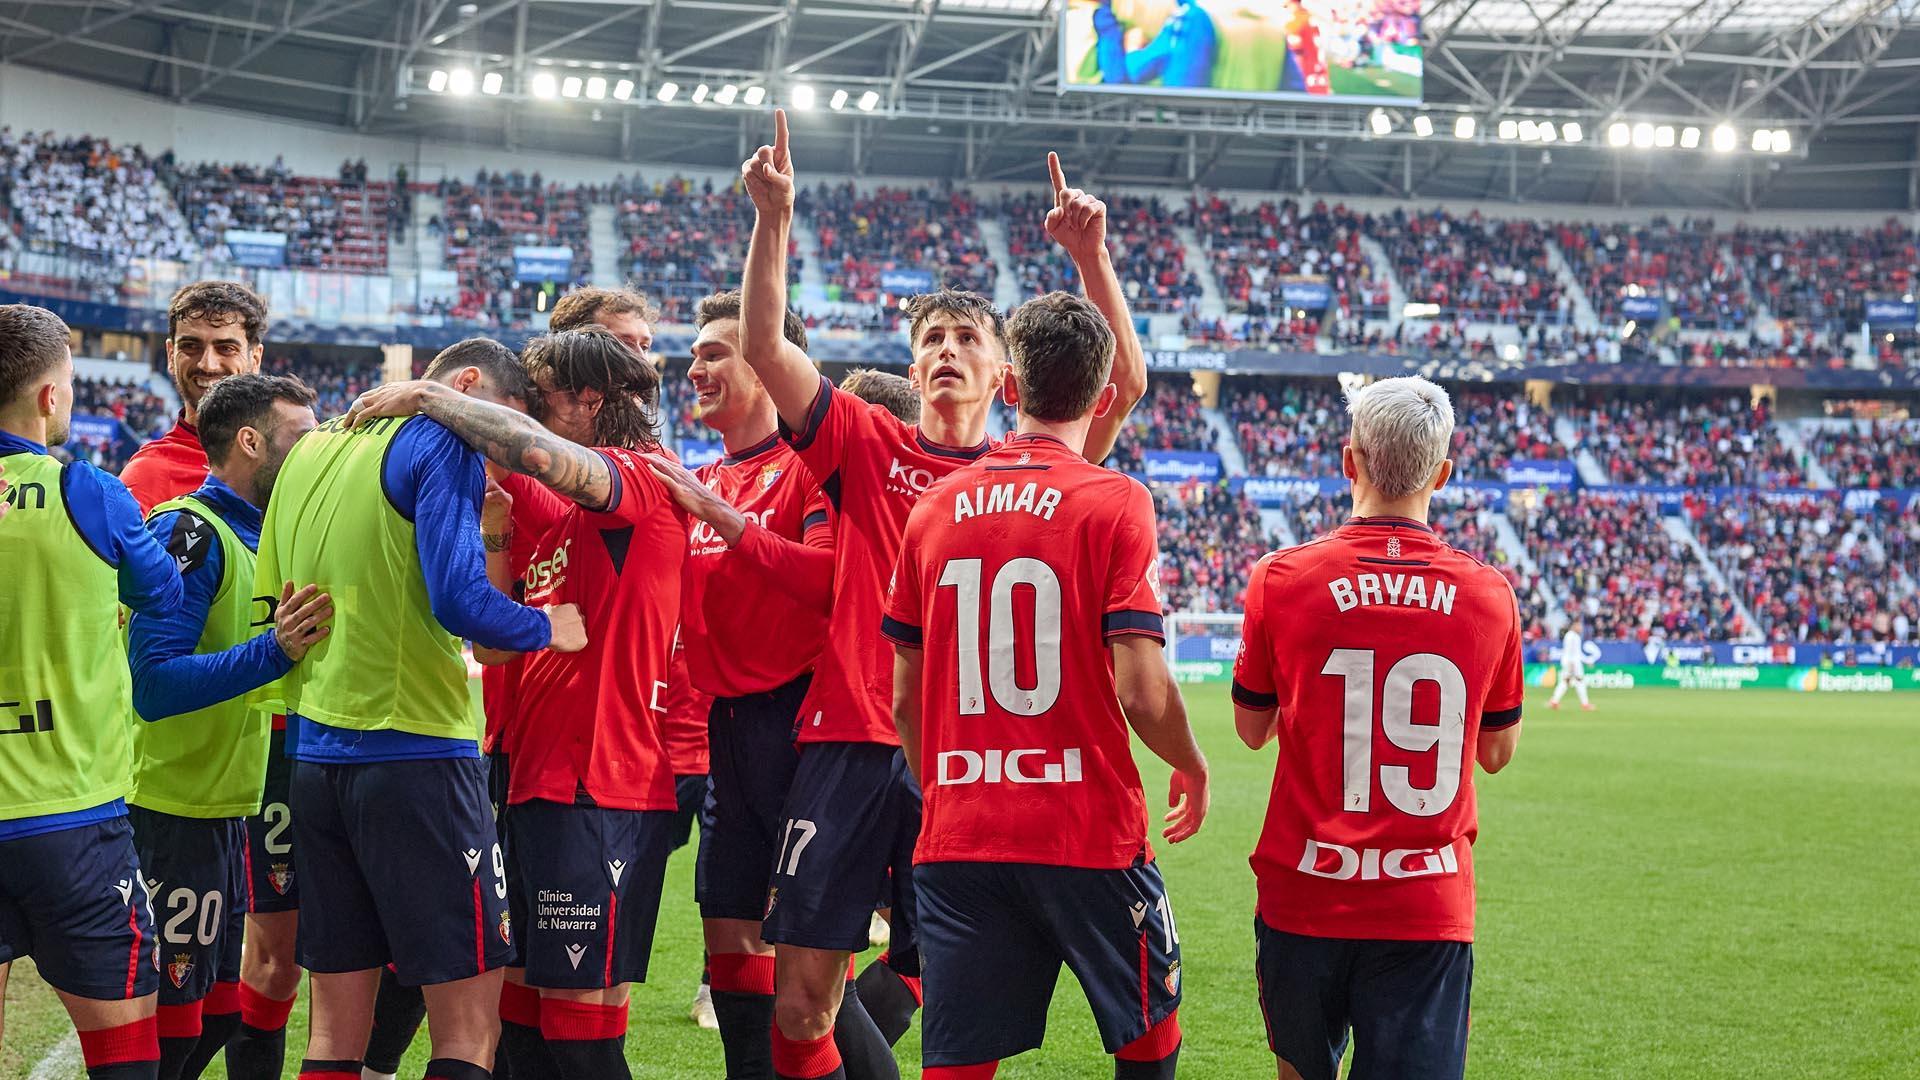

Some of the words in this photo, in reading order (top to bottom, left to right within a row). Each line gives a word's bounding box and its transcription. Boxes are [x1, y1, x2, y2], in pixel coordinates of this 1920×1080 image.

[953, 482, 1063, 523] AIMAR
[1327, 573, 1457, 617] BRYAN
[938, 557, 1063, 717] 10
[1320, 647, 1468, 817] 19
[936, 747, 1083, 786] DIGI
[775, 817, 817, 877] 17
[1296, 838, 1459, 881] DIGI
[492, 842, 508, 900] 9
[163, 886, 223, 946] 20
[537, 903, 601, 917] Universidad
[538, 889, 573, 902] Clínica
[537, 917, 549, 930] de
[550, 917, 597, 931] Navarra
